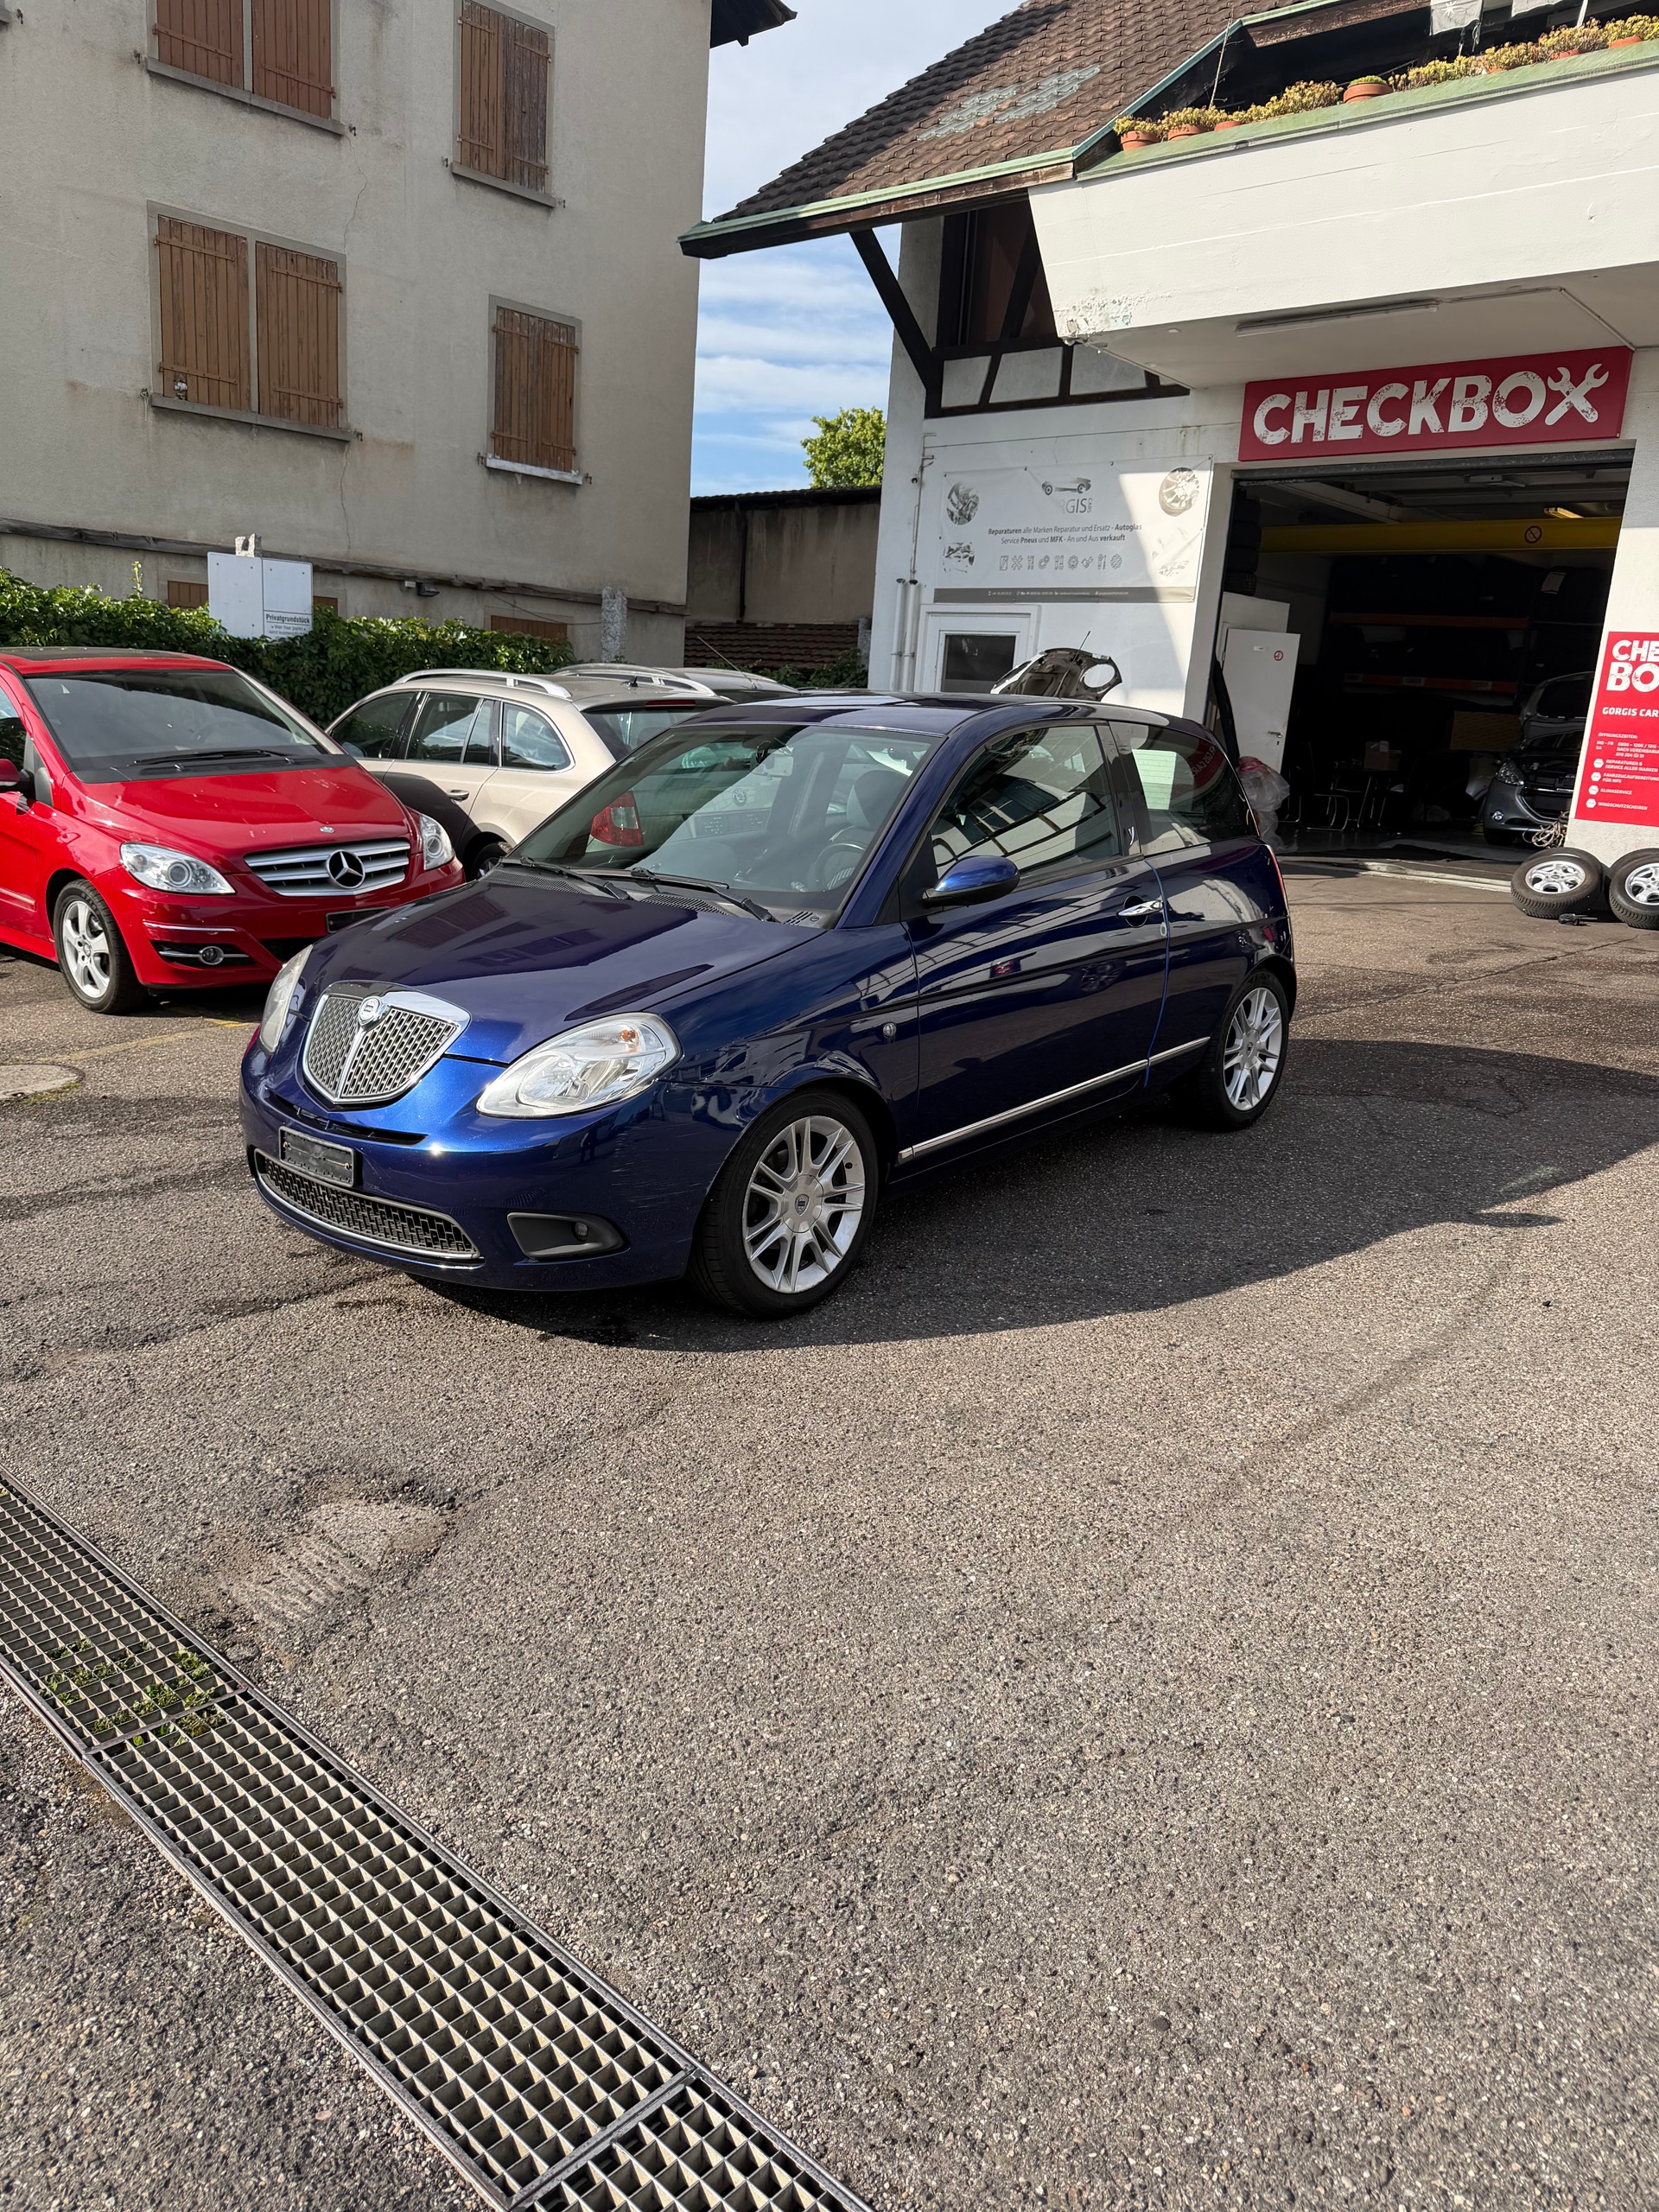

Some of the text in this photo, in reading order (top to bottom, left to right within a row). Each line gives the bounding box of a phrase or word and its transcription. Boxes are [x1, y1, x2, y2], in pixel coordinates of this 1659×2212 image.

[1253, 363, 1610, 446] CHECKBOX
[1054, 525, 1080, 534] Reparatur
[1115, 524, 1141, 532] Autoglas
[266, 613, 310, 623] Privatgrundstück
[1611, 639, 1659, 662] CHE
[1605, 661, 1659, 693] BO
[1602, 706, 1659, 718] GORGIS CAR
